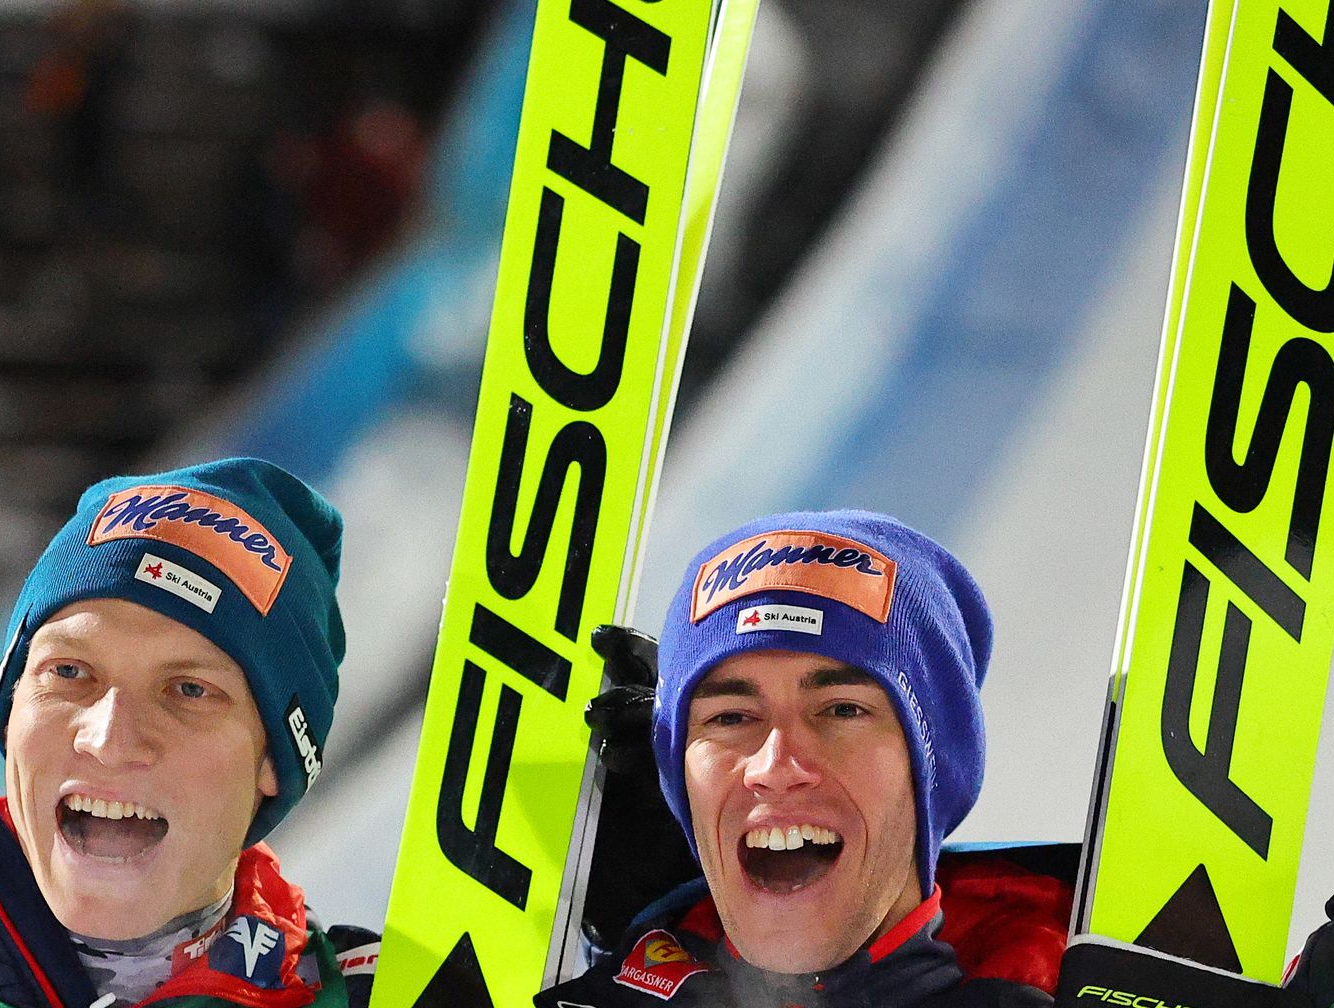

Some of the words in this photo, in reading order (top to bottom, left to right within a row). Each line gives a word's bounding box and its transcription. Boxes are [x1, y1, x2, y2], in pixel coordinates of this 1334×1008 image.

[436, 0, 672, 911] FISCH
[103, 492, 282, 572] Manner
[165, 571, 180, 584] Ski
[181, 580, 213, 603] Austria
[702, 540, 883, 605] Manner
[763, 612, 779, 622] Ski
[782, 614, 817, 625] Austria
[183, 931, 217, 959] Tir
